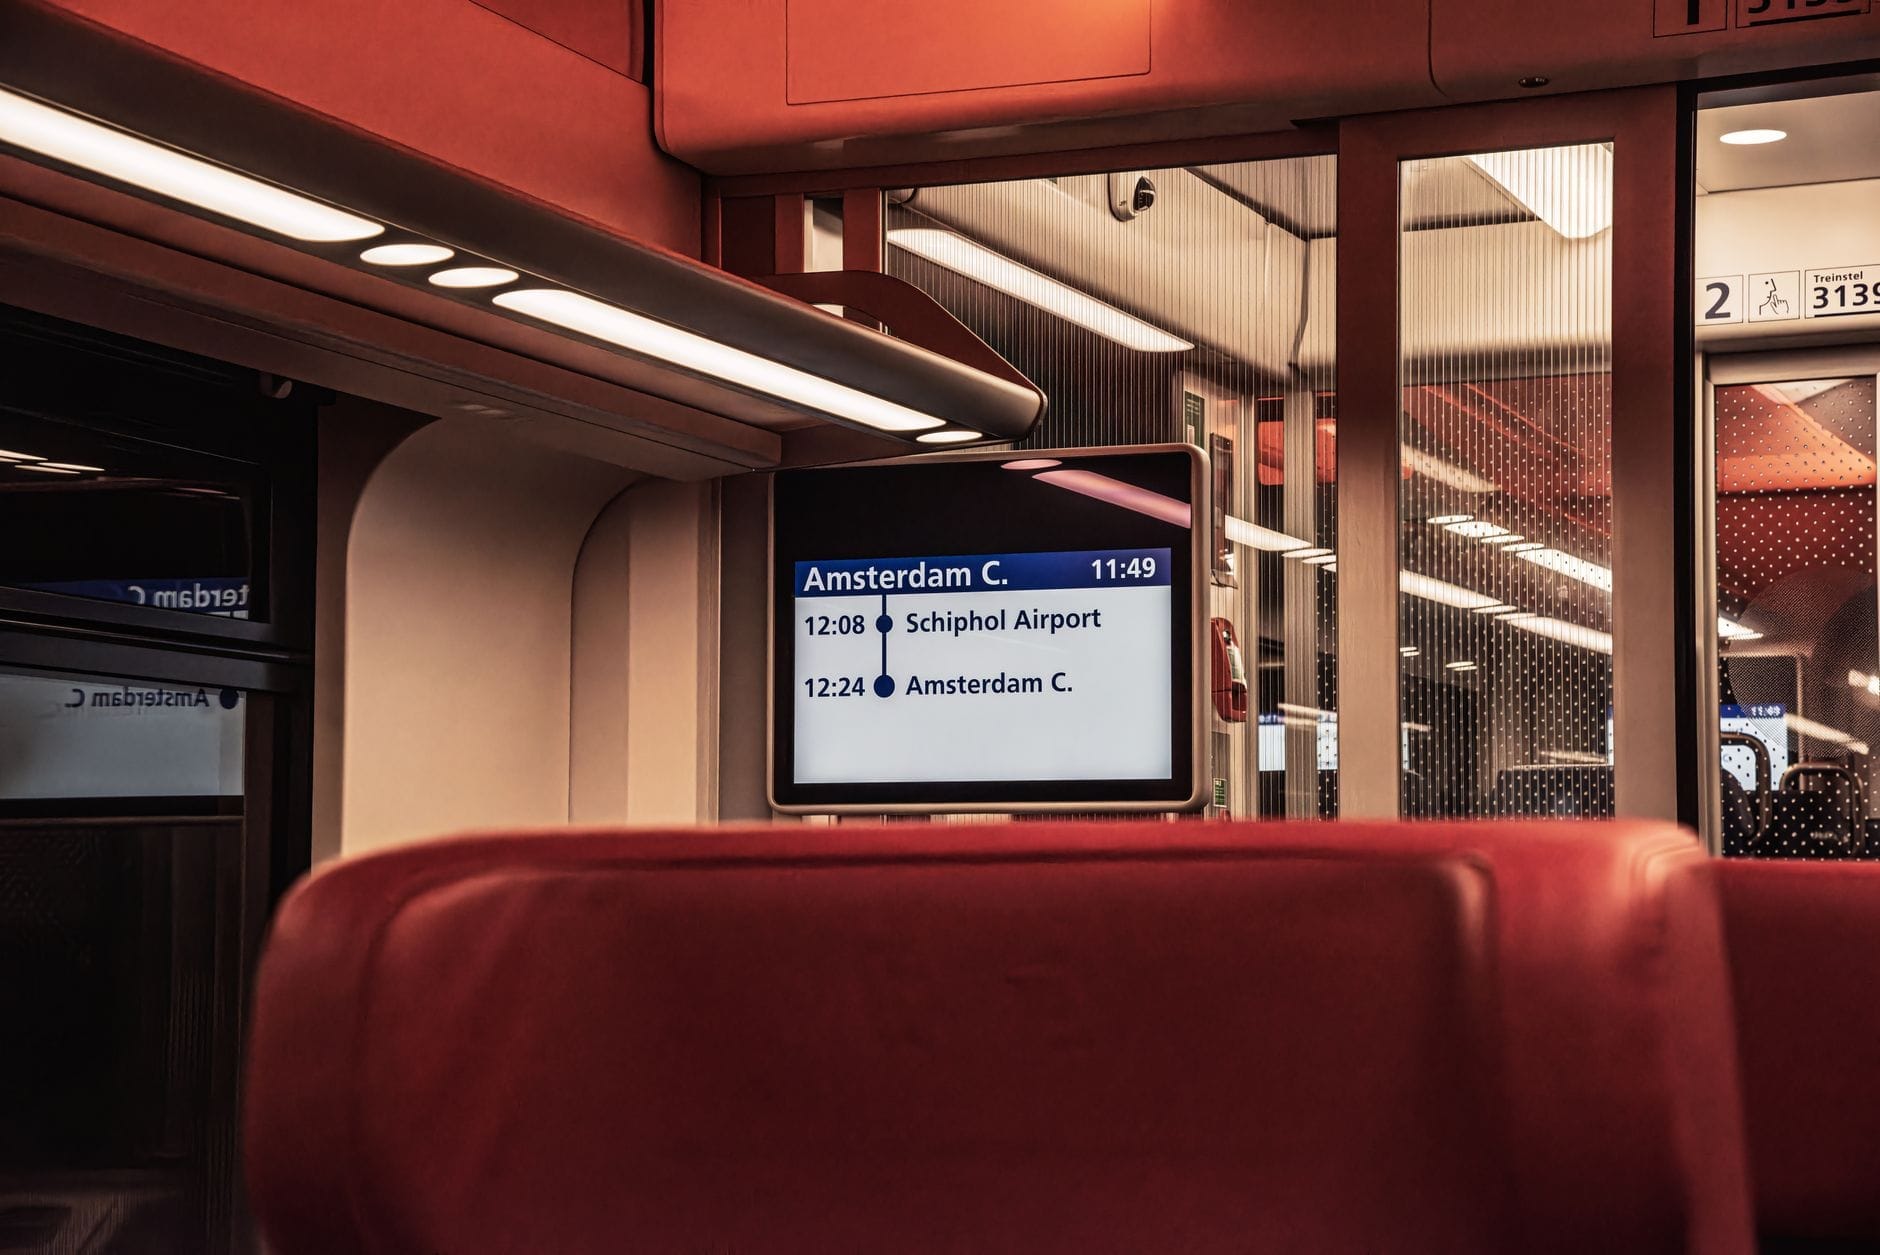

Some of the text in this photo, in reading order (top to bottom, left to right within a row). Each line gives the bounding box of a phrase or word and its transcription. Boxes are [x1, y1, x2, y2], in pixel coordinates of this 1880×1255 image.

[1813, 270, 1864, 283] Treinstel
[1704, 282, 1731, 319] 2
[803, 560, 1008, 591] Amsterdam C.
[1091, 557, 1156, 580] 11:49
[804, 615, 866, 636] 12:08
[906, 608, 1102, 637] Schiphol Airport
[804, 676, 866, 698] 12:24
[905, 671, 1073, 696] Amsterdam C.
